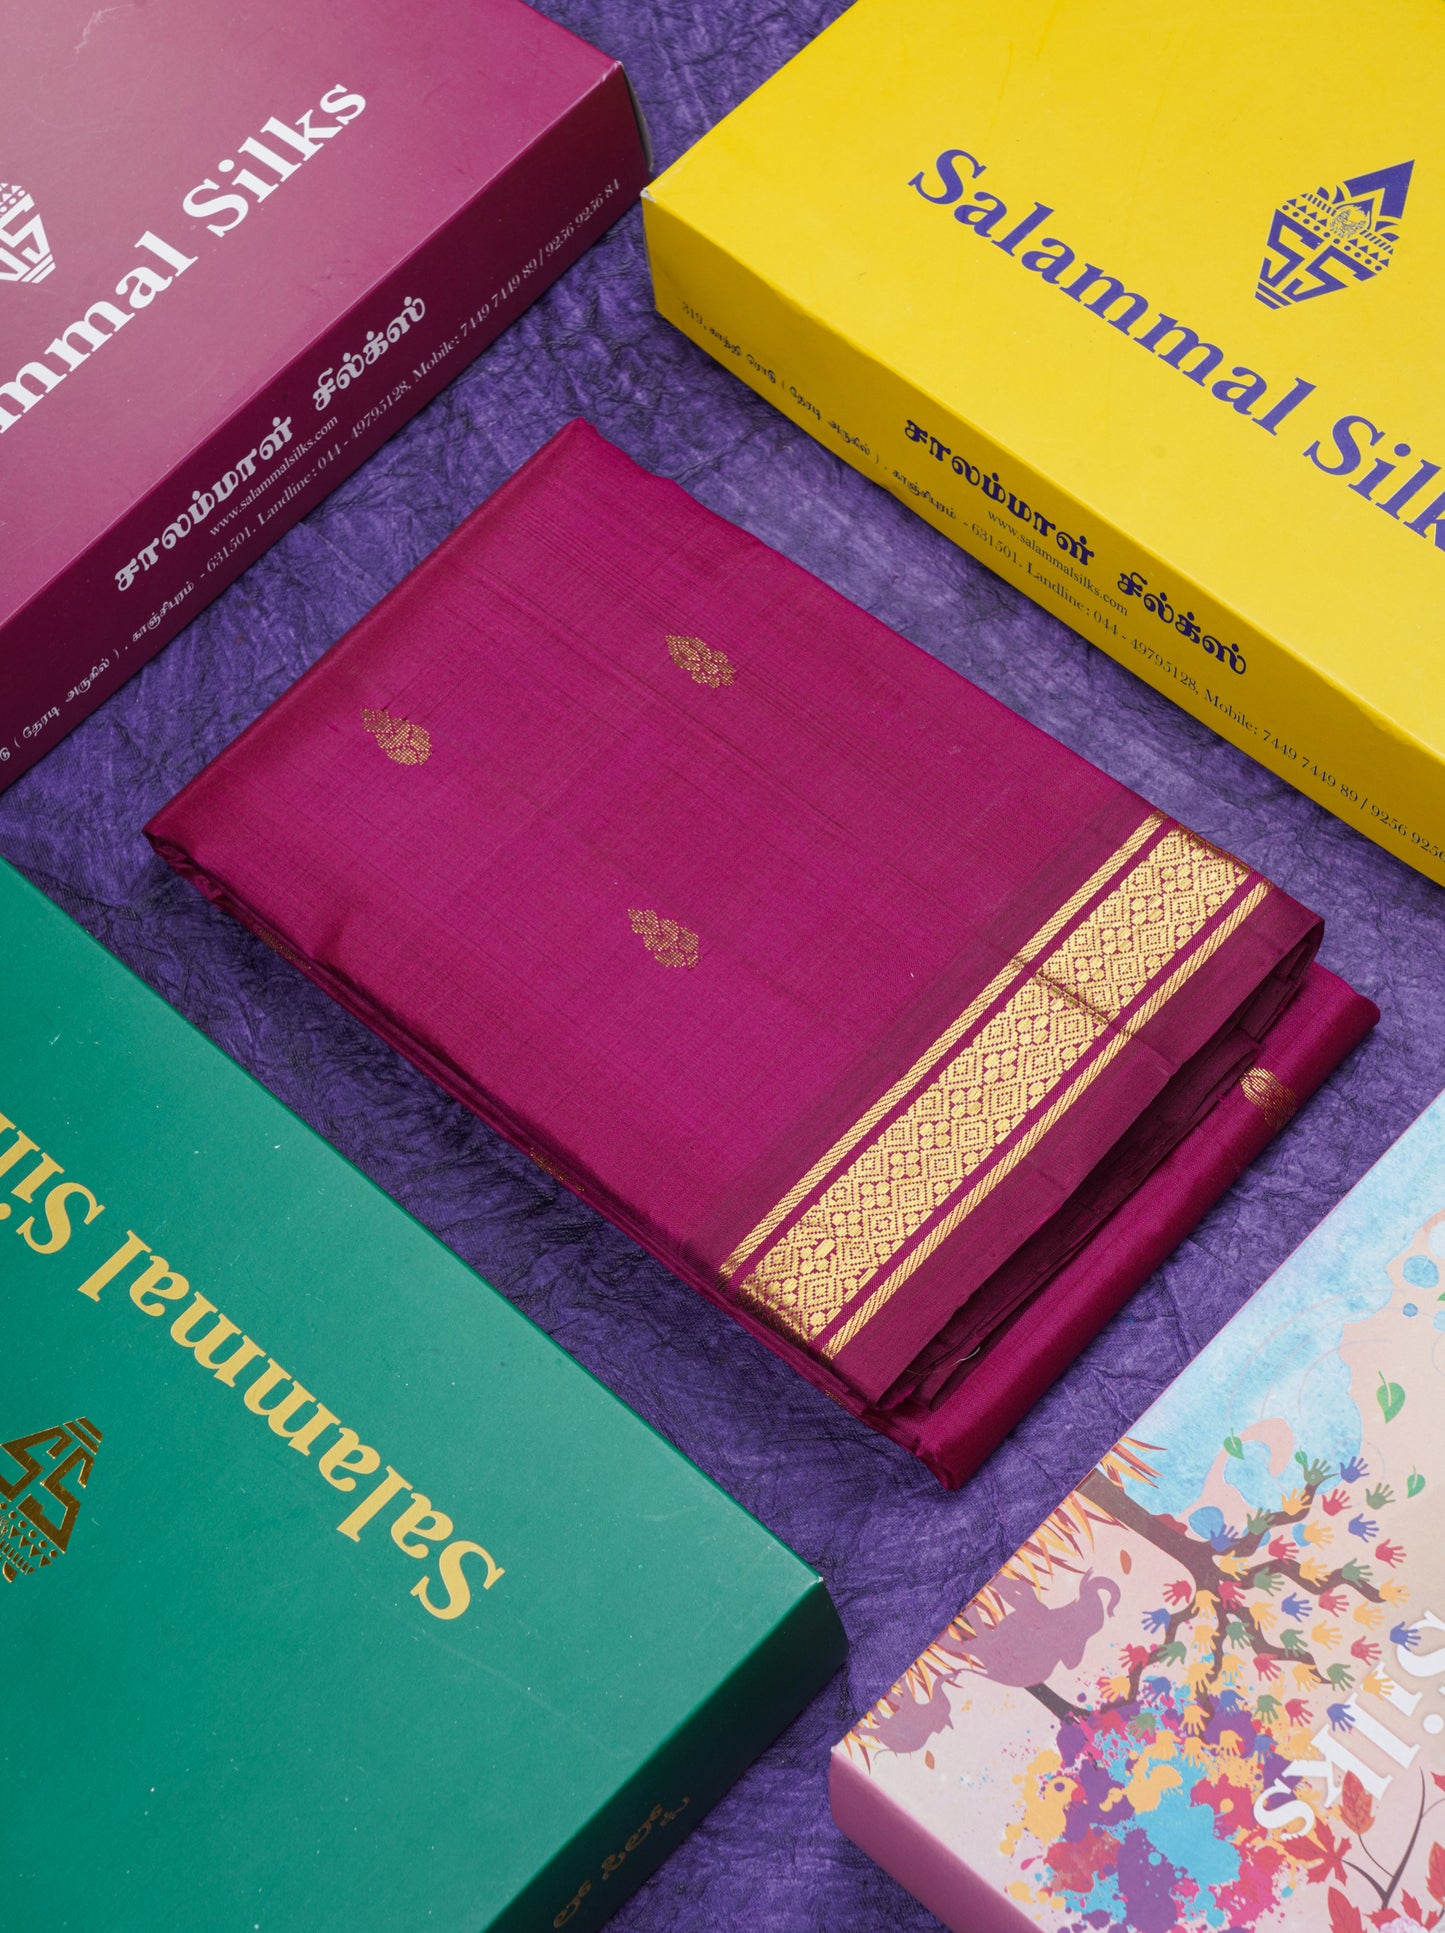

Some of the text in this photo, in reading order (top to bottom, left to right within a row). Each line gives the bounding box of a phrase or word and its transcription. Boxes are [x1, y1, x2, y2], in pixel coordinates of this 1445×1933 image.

[182, 83, 366, 238] Silks
[907, 147, 1317, 437] Salammal
[65, 658, 110, 702] அருகில்
[132, 580, 195, 642] காஞ்சிபுரம்
[317, 442, 342, 471] 044
[415, 335, 460, 382] Mobile:
[460, 304, 491, 337] 7449
[491, 274, 521, 309] 7449
[522, 258, 538, 279] 89
[545, 222, 575, 257] 9256
[575, 193, 604, 228] 9256
[604, 177, 621, 198] 84
[114, 296, 426, 592] சாலம்மாள் சில்க்ஸ்
[210, 416, 339, 537] www.salammalsilks.com
[904, 419, 1246, 675] சாலம்மாள் சில்க்ஸ்
[988, 510, 1128, 617] www.salammalsilks.com
[827, 421, 870, 456] அருகில்
[892, 470, 957, 520] காஞ்சிபுரம்
[1093, 609, 1118, 636] 044
[1204, 688, 1258, 735] Mobile:
[1262, 729, 1297, 760] 7449
[1302, 756, 1336, 788] 7449
[1340, 783, 1358, 802] 89
[1370, 804, 1407, 836] 9256
[78, 1231, 505, 1620] Salammal
